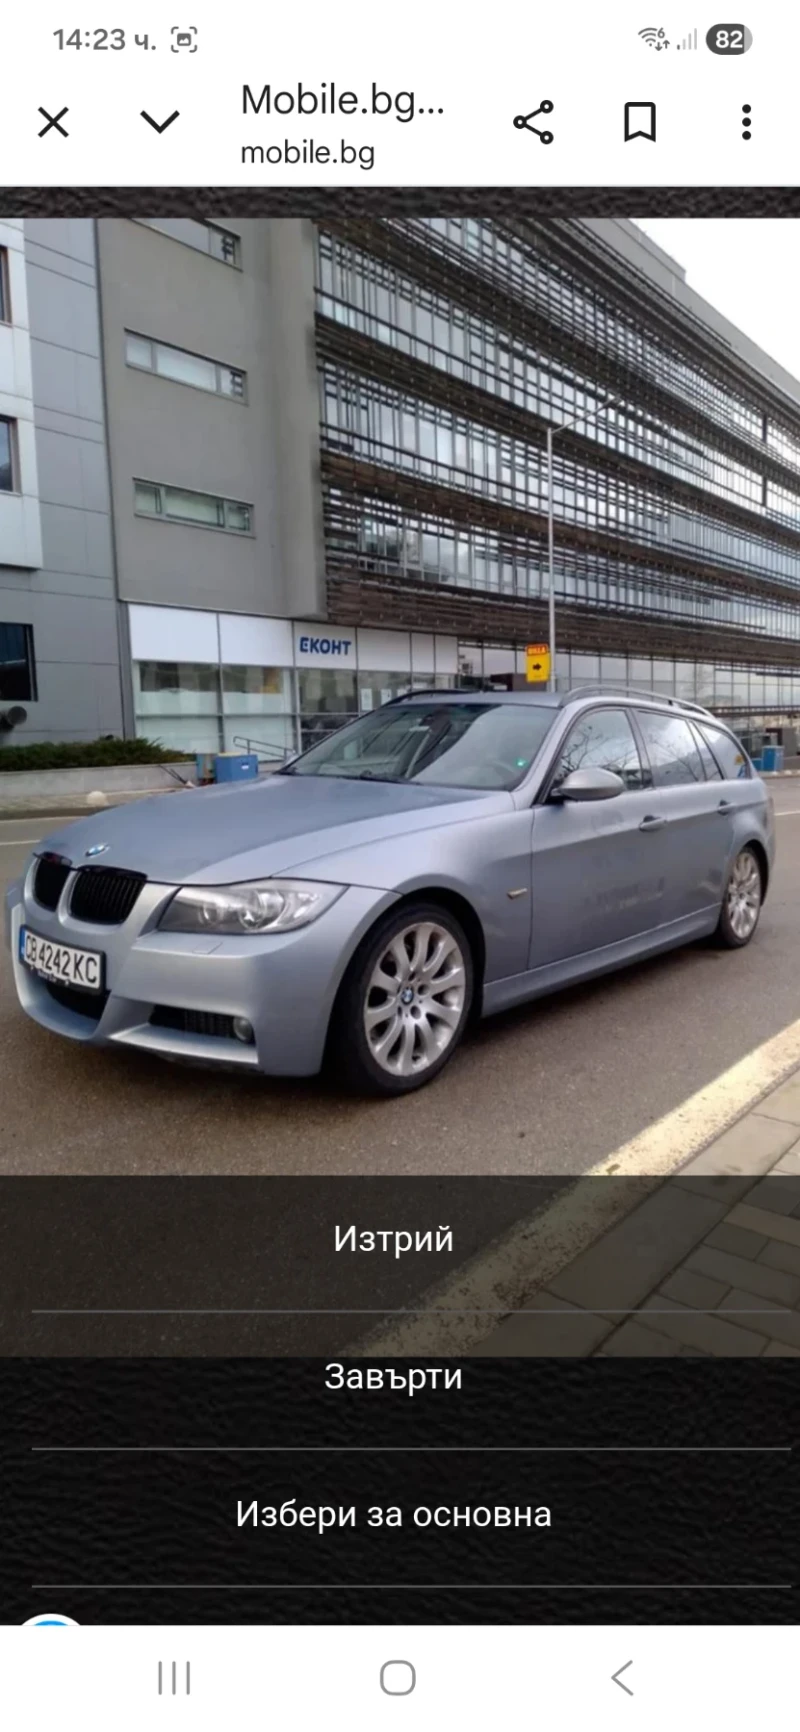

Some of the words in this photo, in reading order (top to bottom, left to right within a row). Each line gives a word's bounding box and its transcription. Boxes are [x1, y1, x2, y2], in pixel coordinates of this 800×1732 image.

[299, 636, 352, 656] ЕКОНТ
[38, 943, 71, 977] 4242
[73, 952, 97, 984] KC
